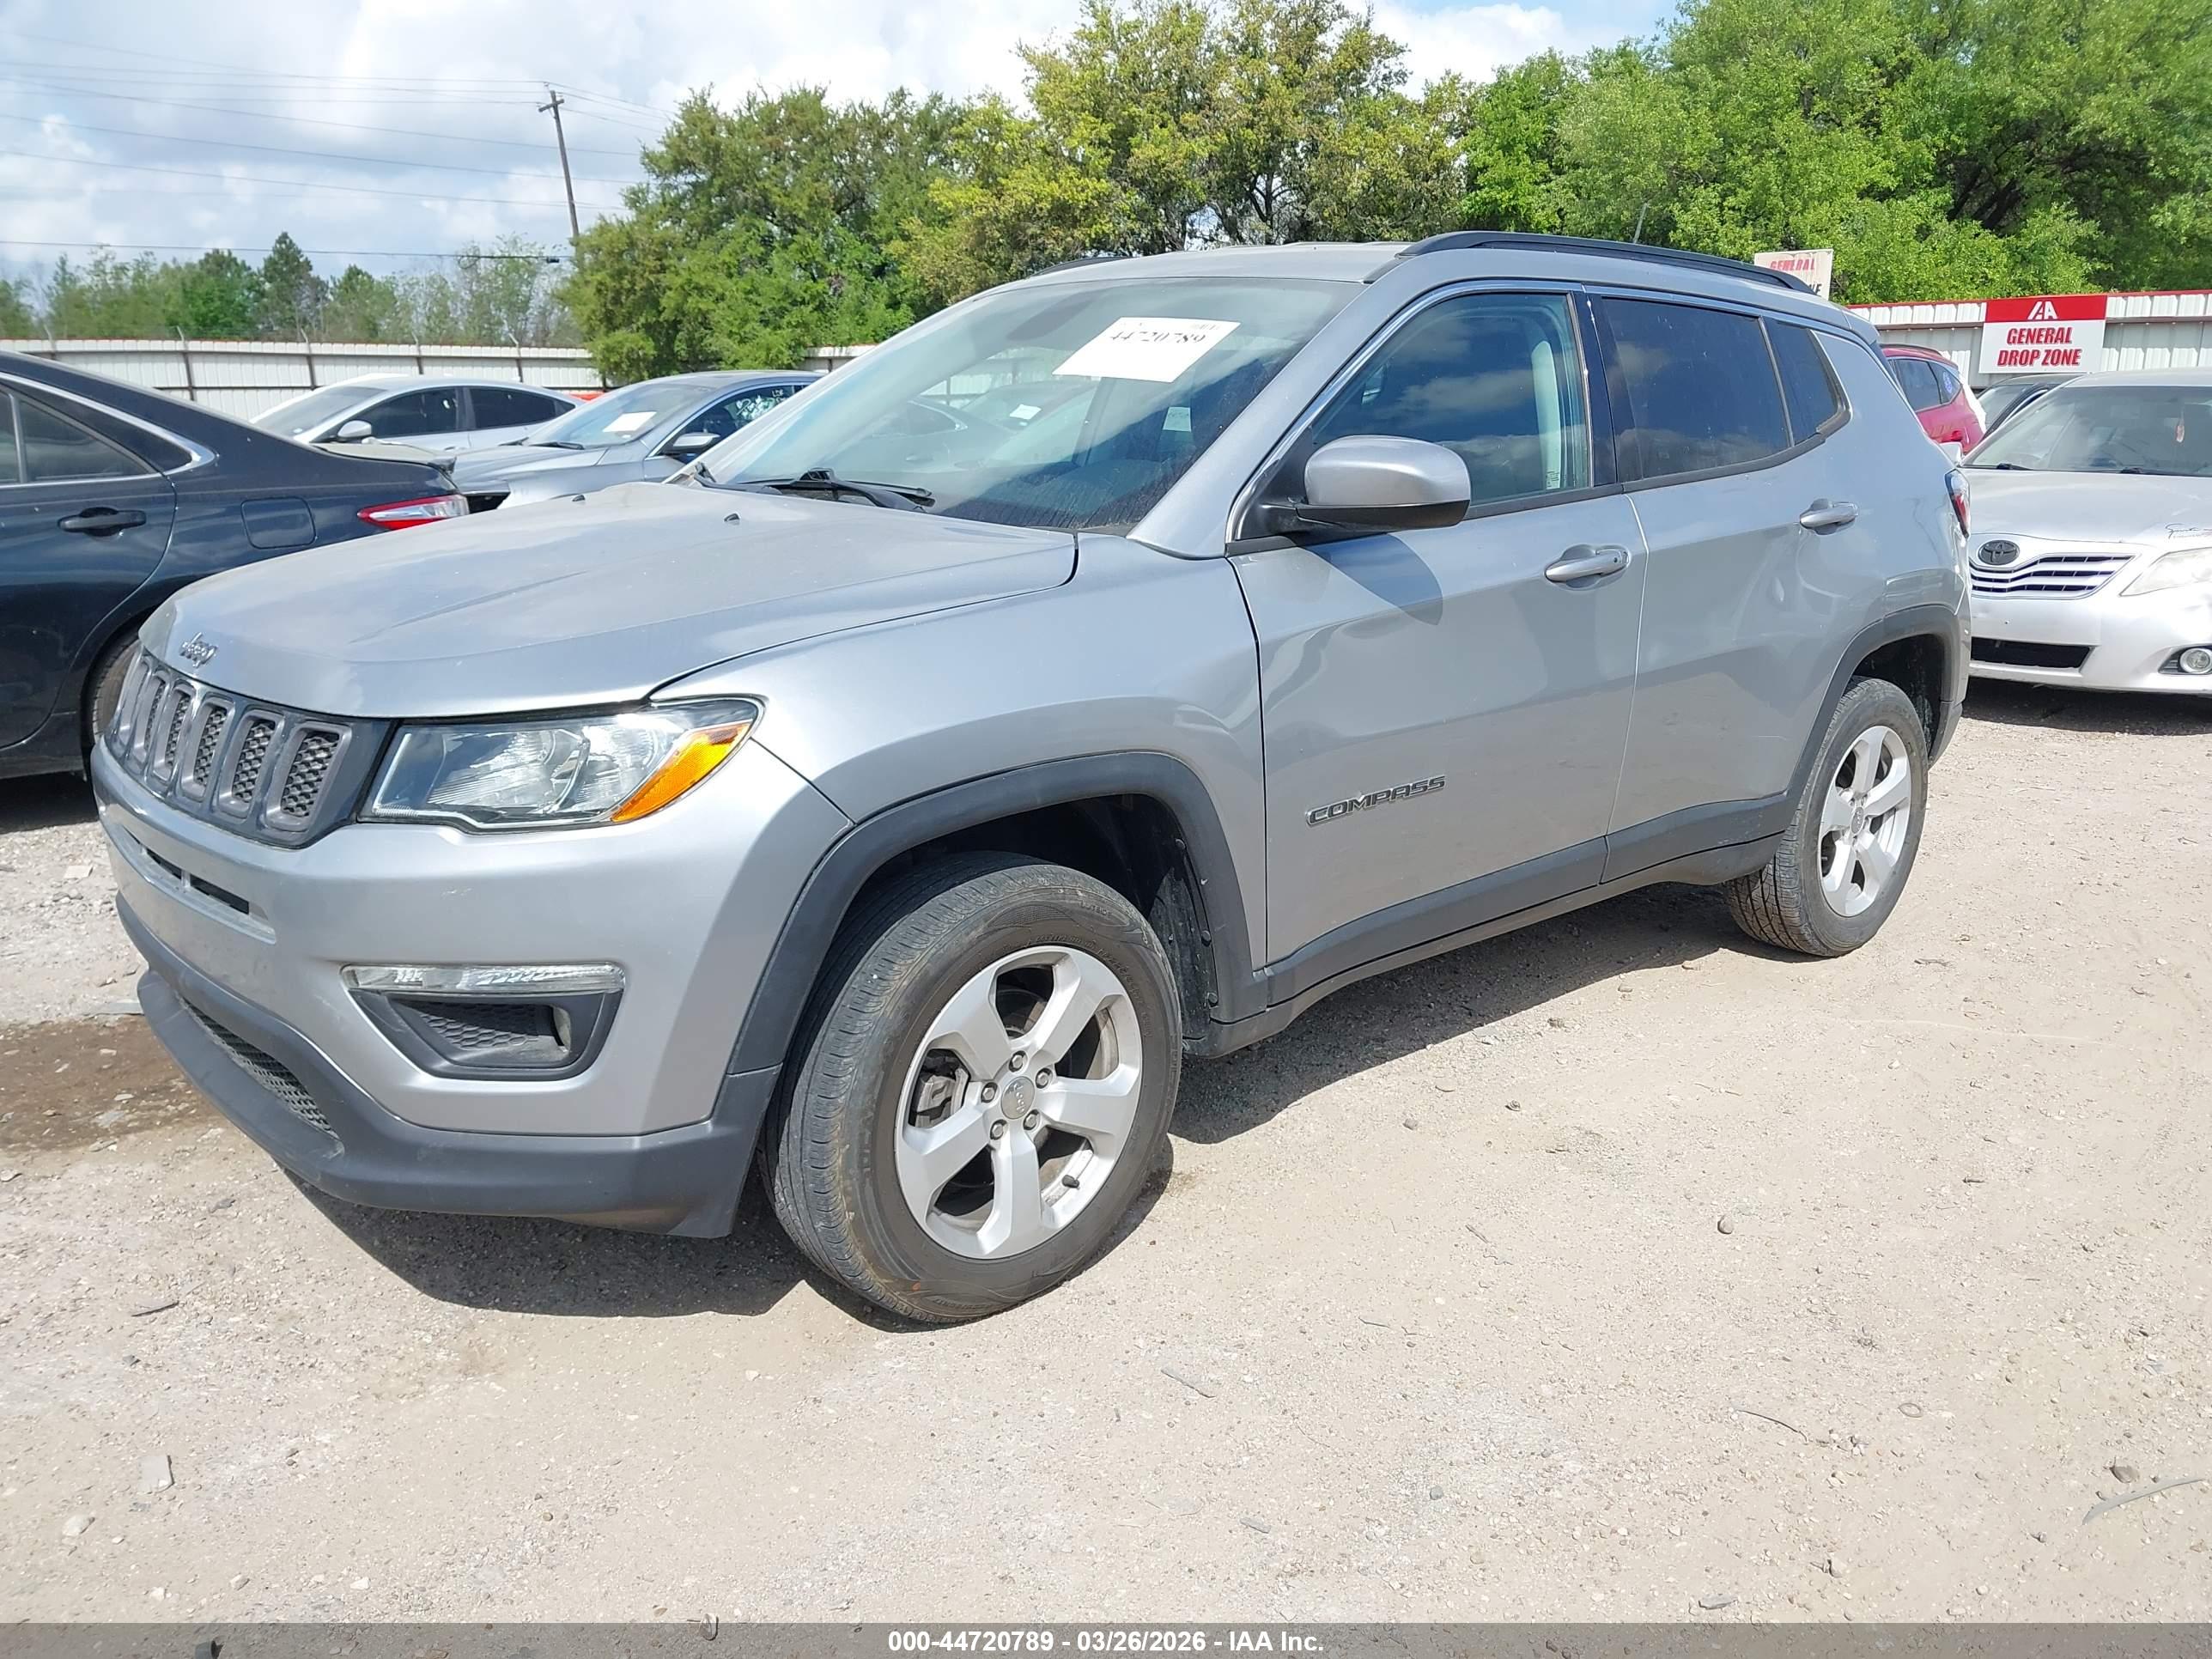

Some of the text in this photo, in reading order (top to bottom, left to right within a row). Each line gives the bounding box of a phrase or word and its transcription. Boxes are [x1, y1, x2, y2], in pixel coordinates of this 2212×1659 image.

[2006, 327, 2072, 344] GENERAL
[1997, 349, 2081, 367] DROP ZONE
[1305, 775, 1446, 826] COMPASS
